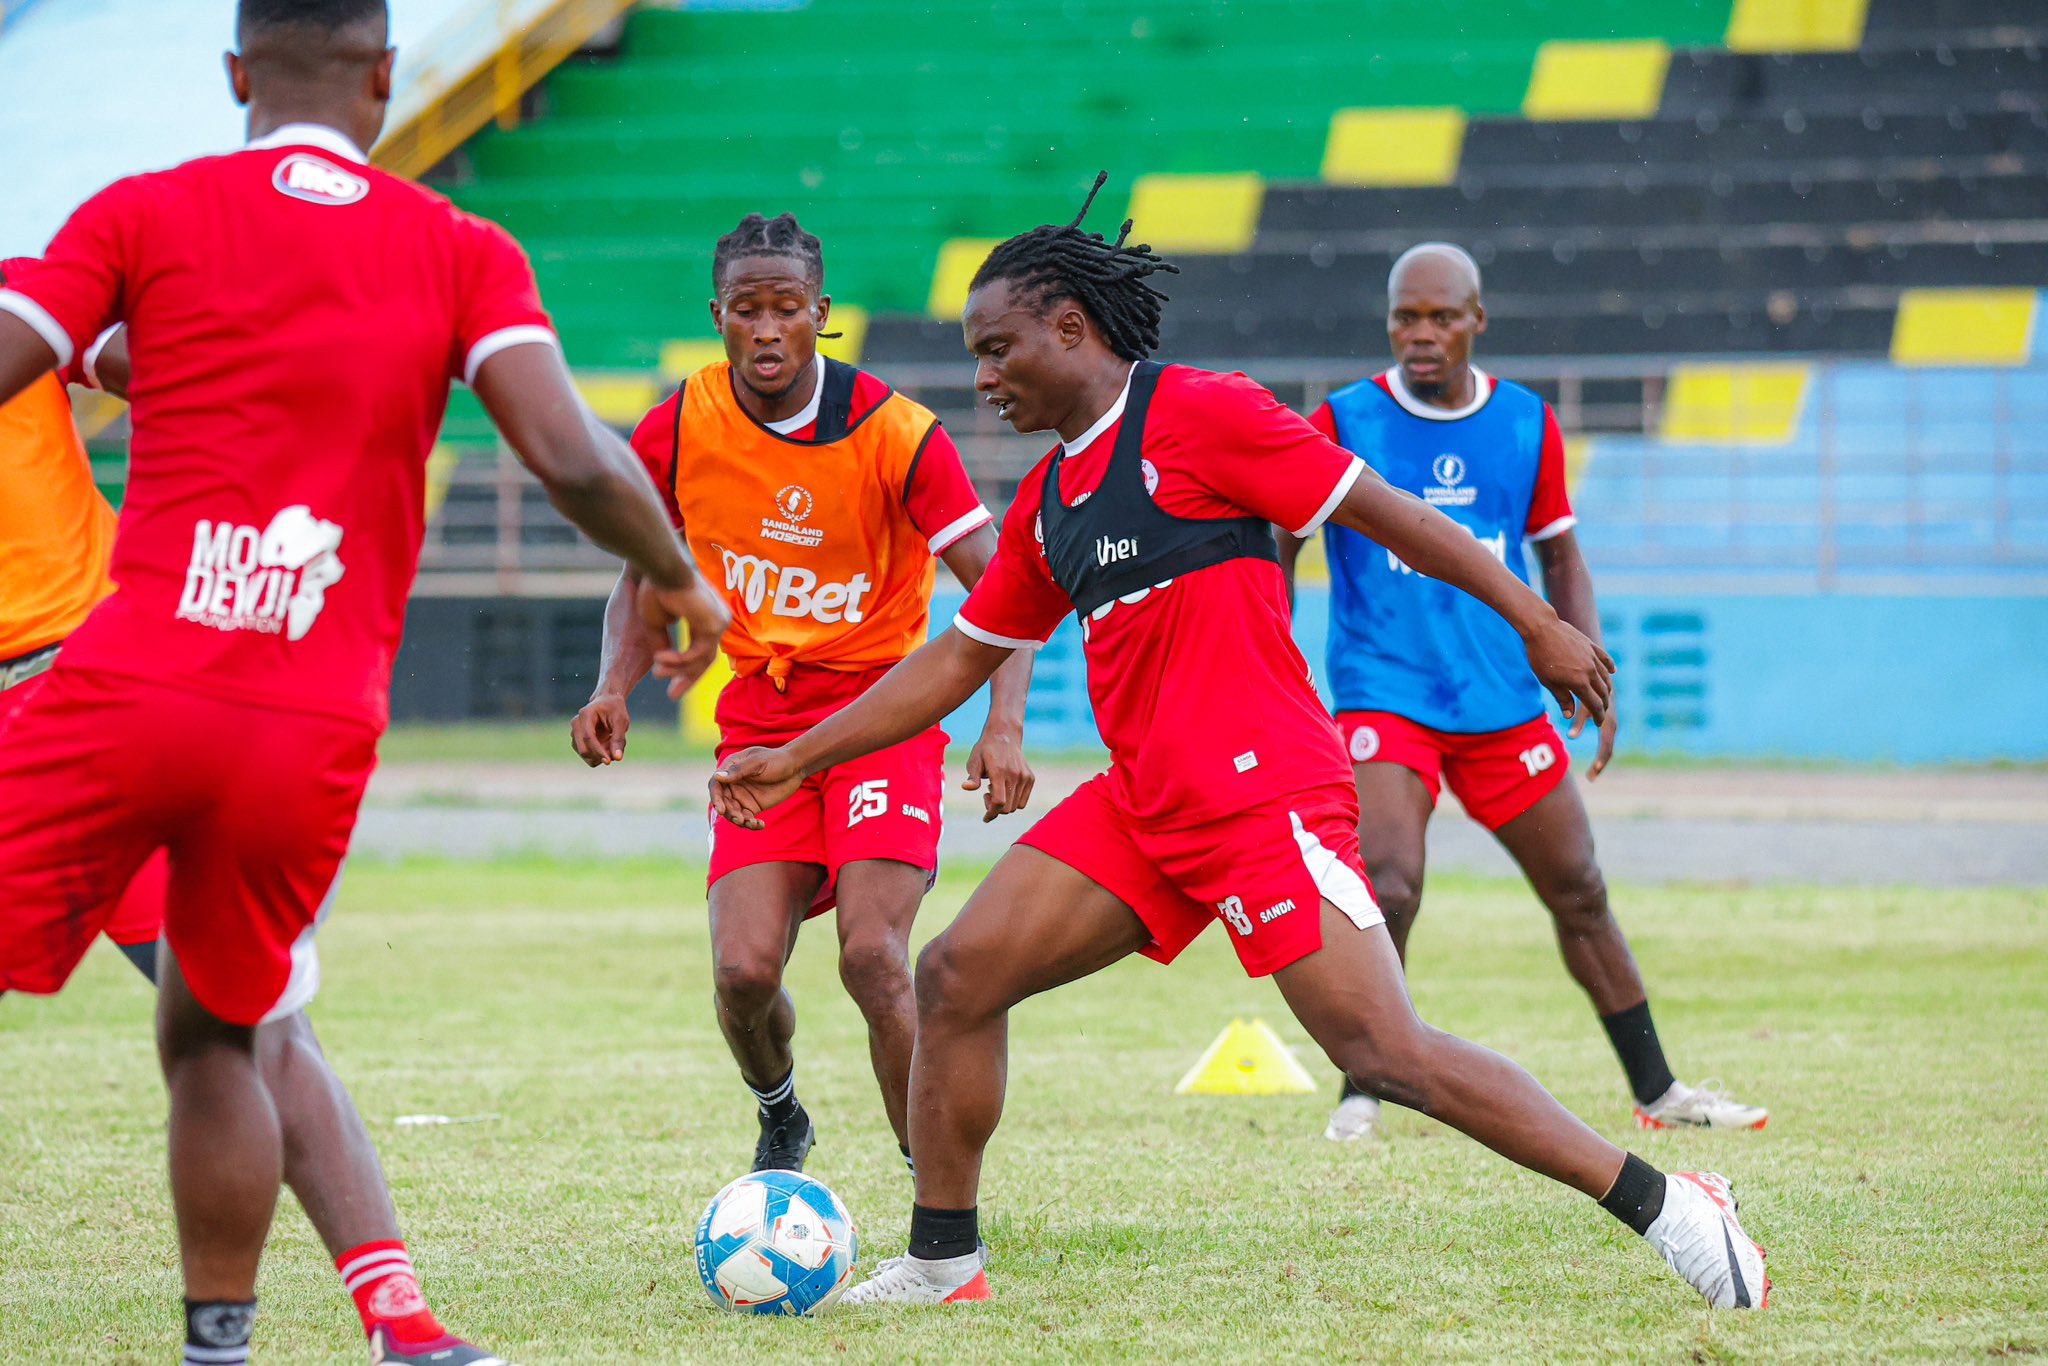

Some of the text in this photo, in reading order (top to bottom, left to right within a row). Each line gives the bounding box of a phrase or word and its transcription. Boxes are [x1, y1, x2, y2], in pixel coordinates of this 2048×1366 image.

[760, 528, 823, 547] MOSPORT
[761, 518, 824, 537] SANDALAND
[190, 519, 261, 576] MO
[178, 566, 296, 621] DEWJI
[1519, 743, 1556, 777] 10
[847, 779, 888, 828] 25
[902, 803, 930, 824] SANDA
[1260, 898, 1296, 924] SANDA
